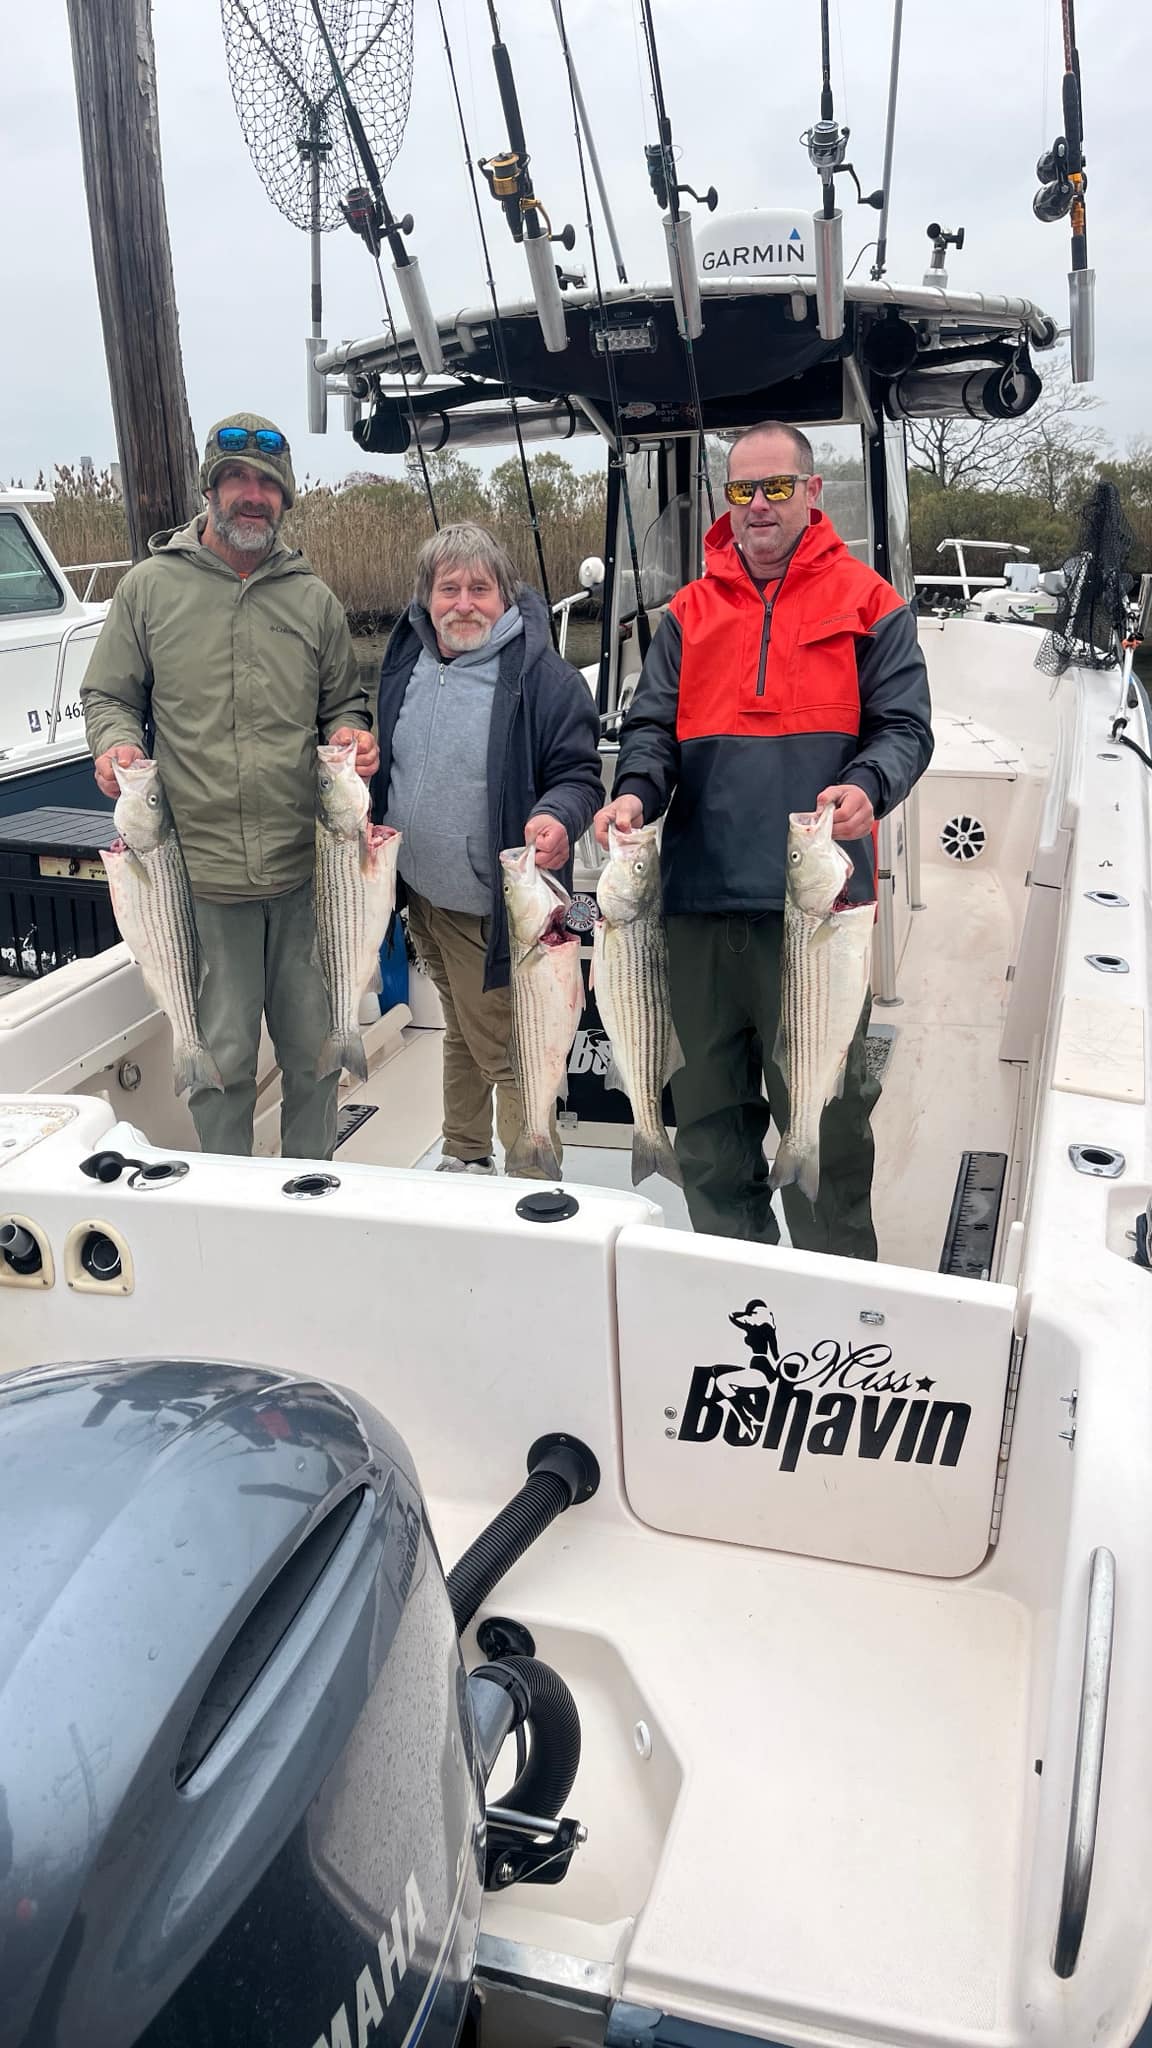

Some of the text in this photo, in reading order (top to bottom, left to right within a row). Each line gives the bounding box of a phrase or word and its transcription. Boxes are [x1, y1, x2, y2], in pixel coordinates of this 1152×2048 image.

[702, 244, 804, 270] GARMIN
[778, 1340, 914, 1393] Miss
[678, 1365, 971, 1472] Behavin
